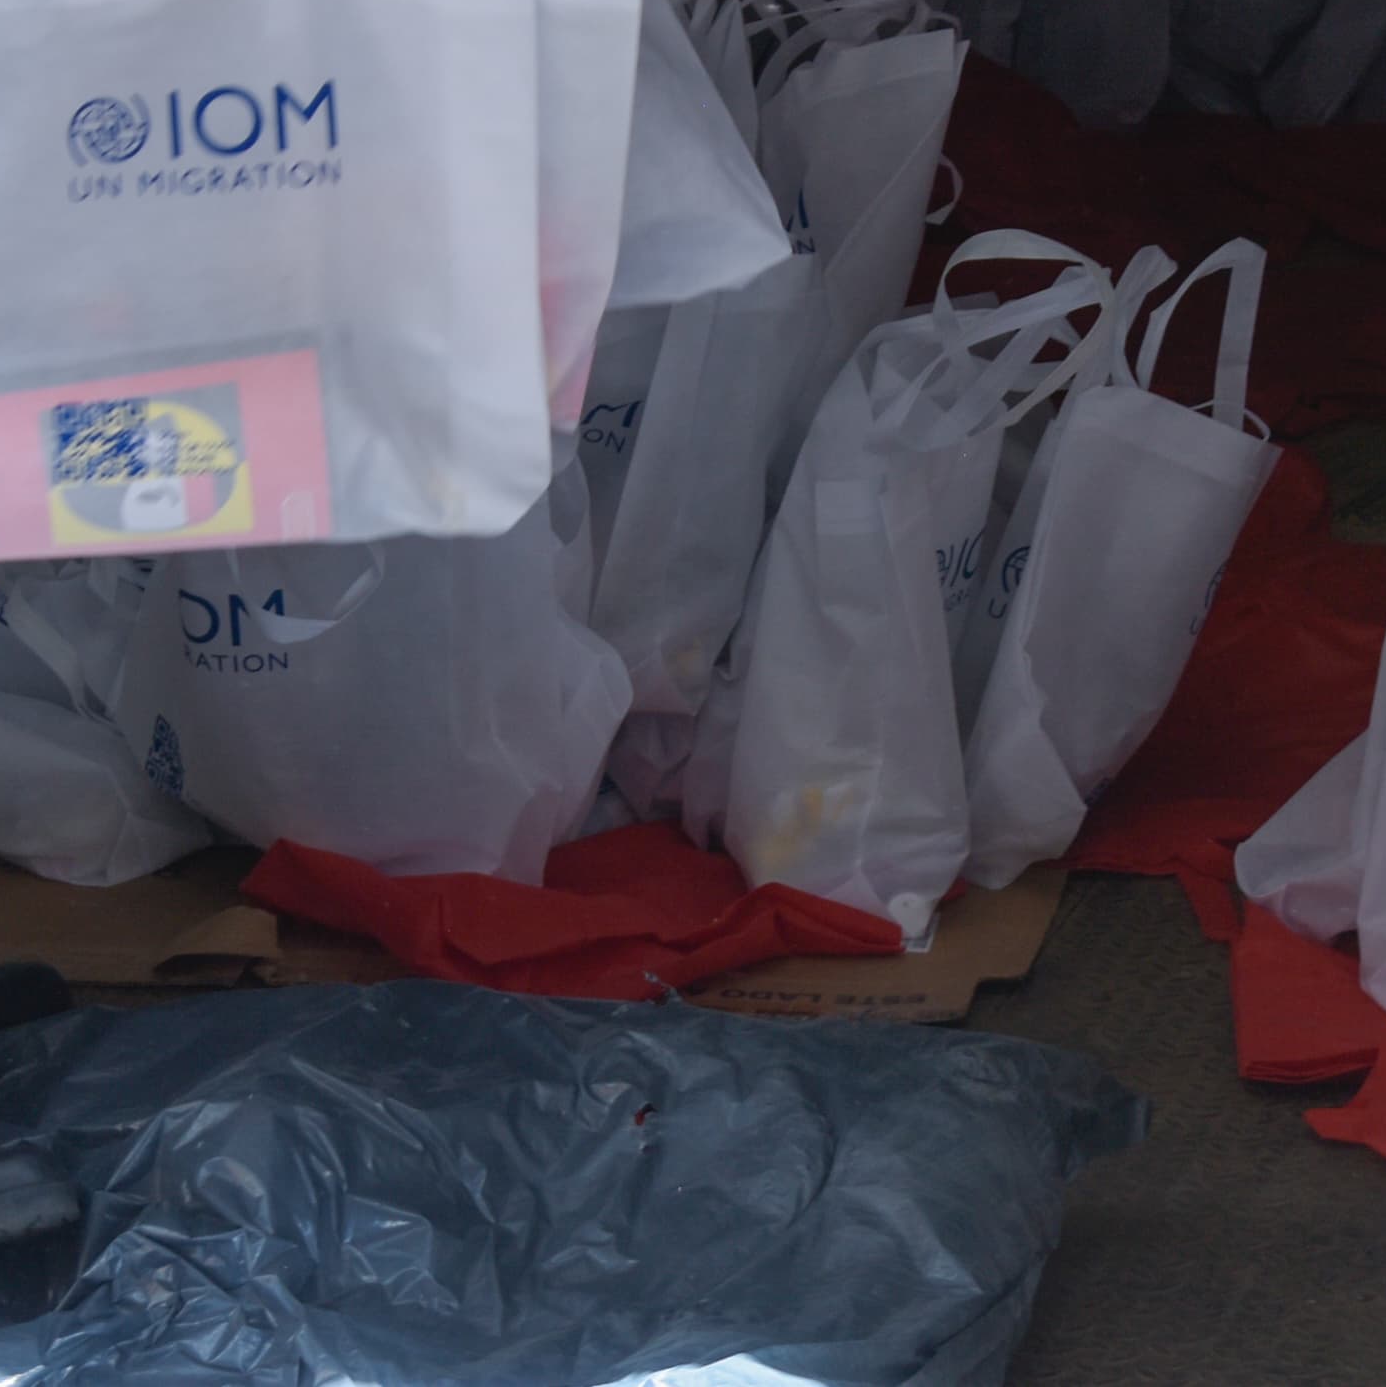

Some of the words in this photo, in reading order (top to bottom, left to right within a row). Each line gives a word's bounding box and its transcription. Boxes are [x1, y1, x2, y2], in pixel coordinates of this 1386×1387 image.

[168, 78, 341, 159] IOM
[67, 170, 124, 204] UN
[136, 158, 343, 198] MIGRATION
[177, 587, 286, 647] OM
